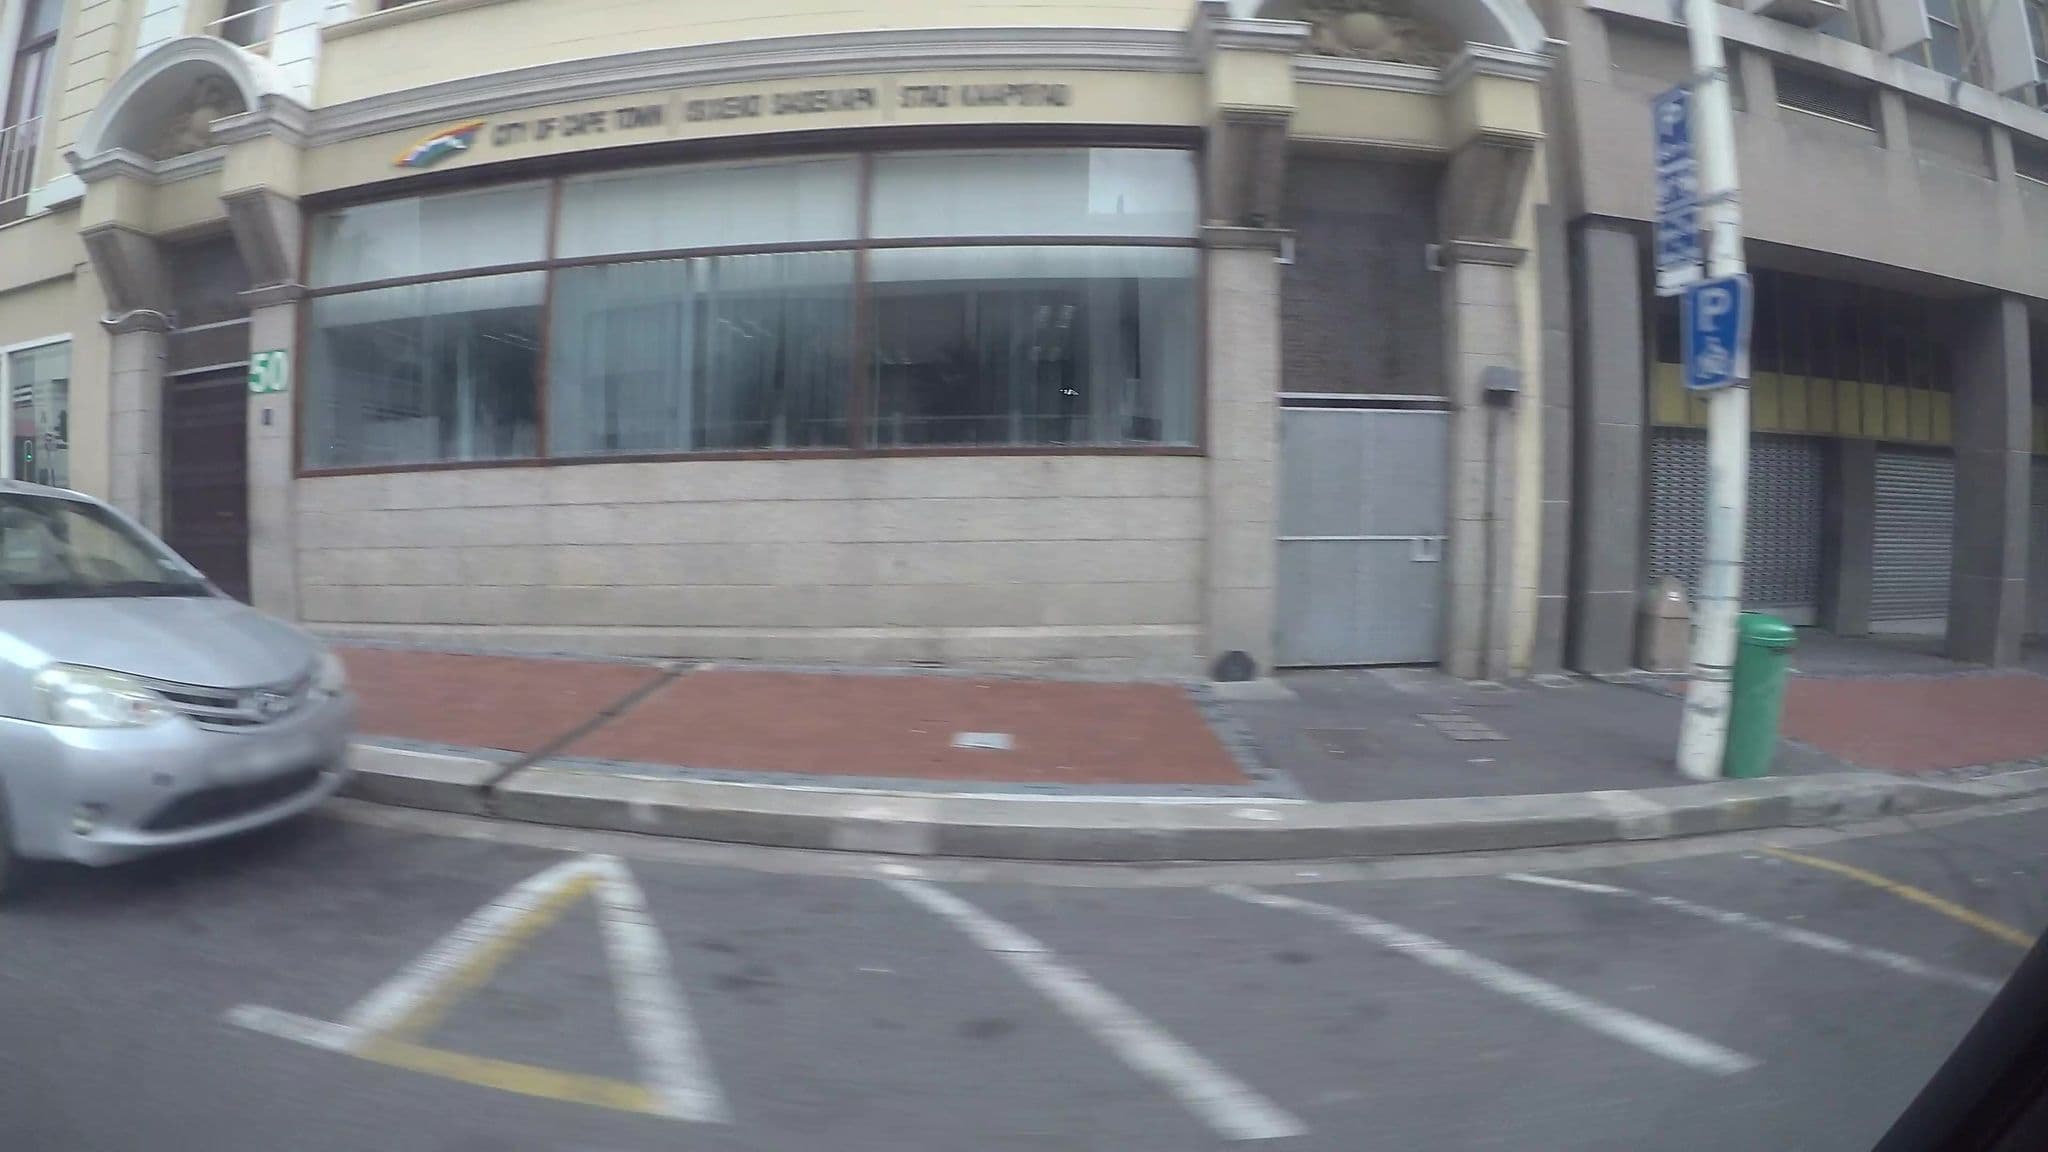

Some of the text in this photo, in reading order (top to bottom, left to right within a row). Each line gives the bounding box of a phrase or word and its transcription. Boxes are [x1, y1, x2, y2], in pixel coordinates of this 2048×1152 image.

[493, 120, 528, 146] CITY
[534, 117, 560, 142] OF
[561, 111, 607, 138] CAPE
[614, 106, 664, 132] TOWN
[900, 84, 952, 109] STAD
[1697, 287, 1731, 331] P
[248, 350, 288, 394] 50
